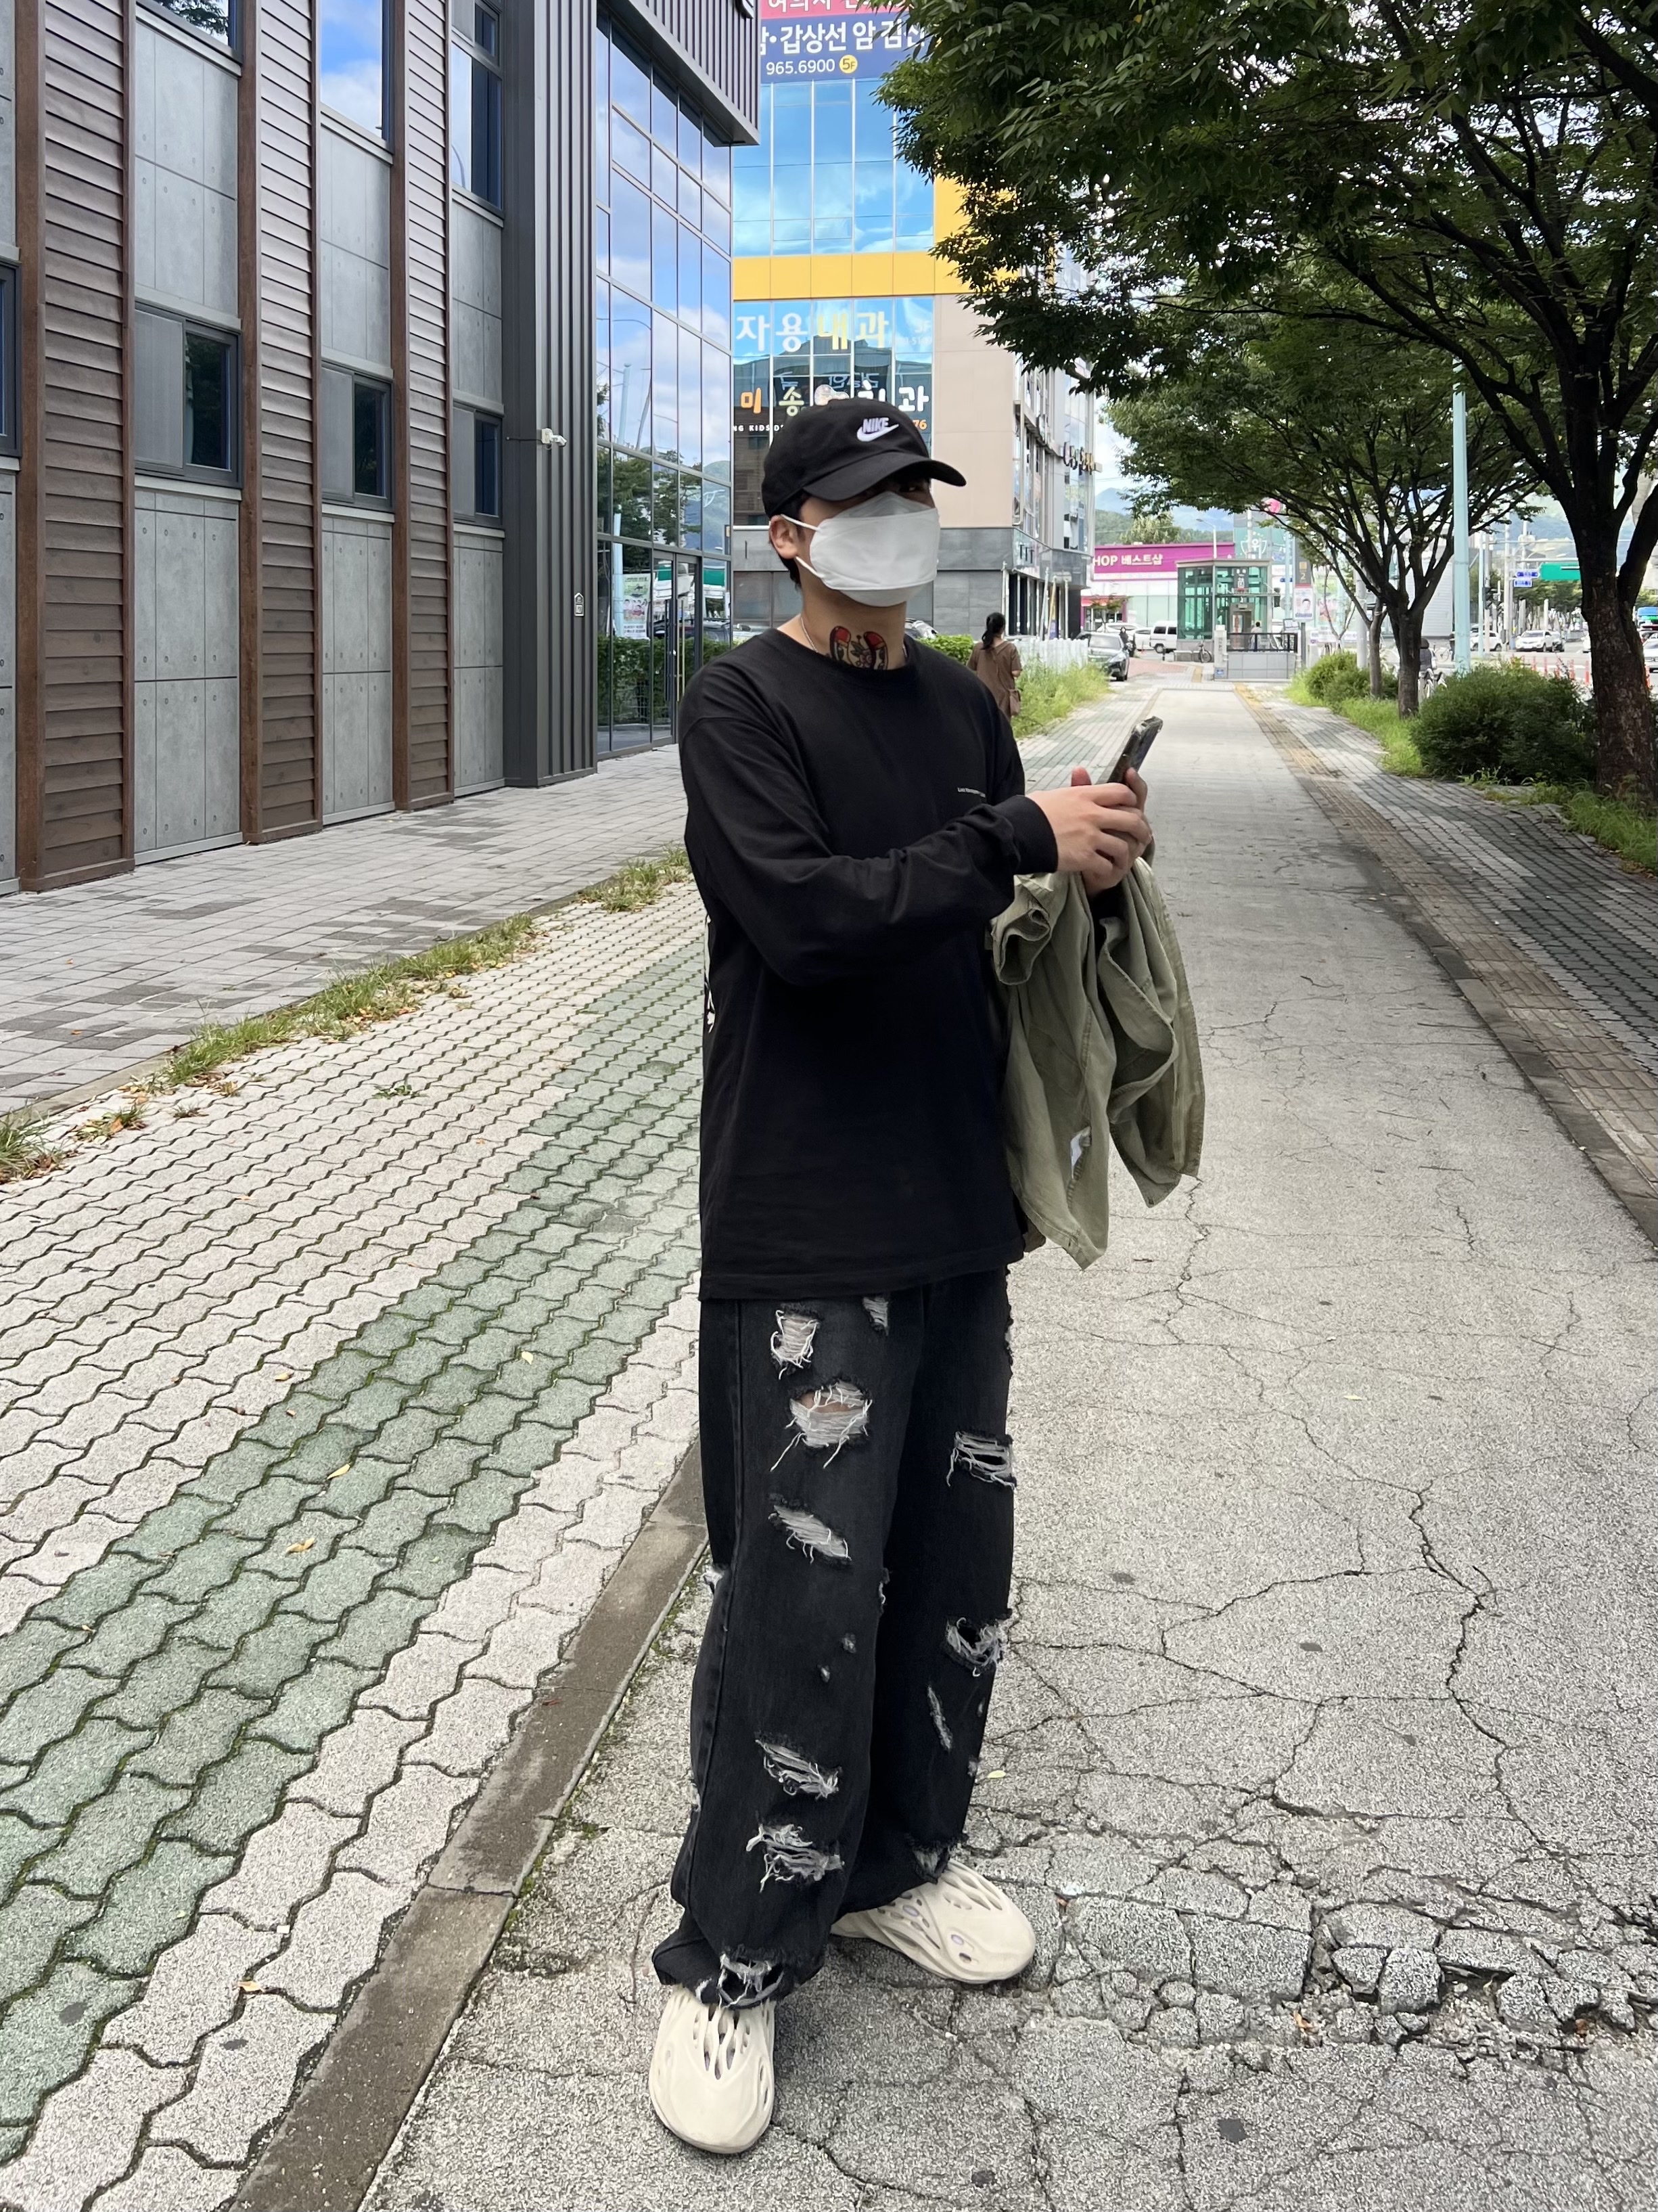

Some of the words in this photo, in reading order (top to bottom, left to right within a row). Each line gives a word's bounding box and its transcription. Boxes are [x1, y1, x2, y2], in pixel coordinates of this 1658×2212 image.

[766, 59, 835, 75] 965.6900
[841, 58, 856, 70] 5F
[862, 417, 890, 434] NIKE
